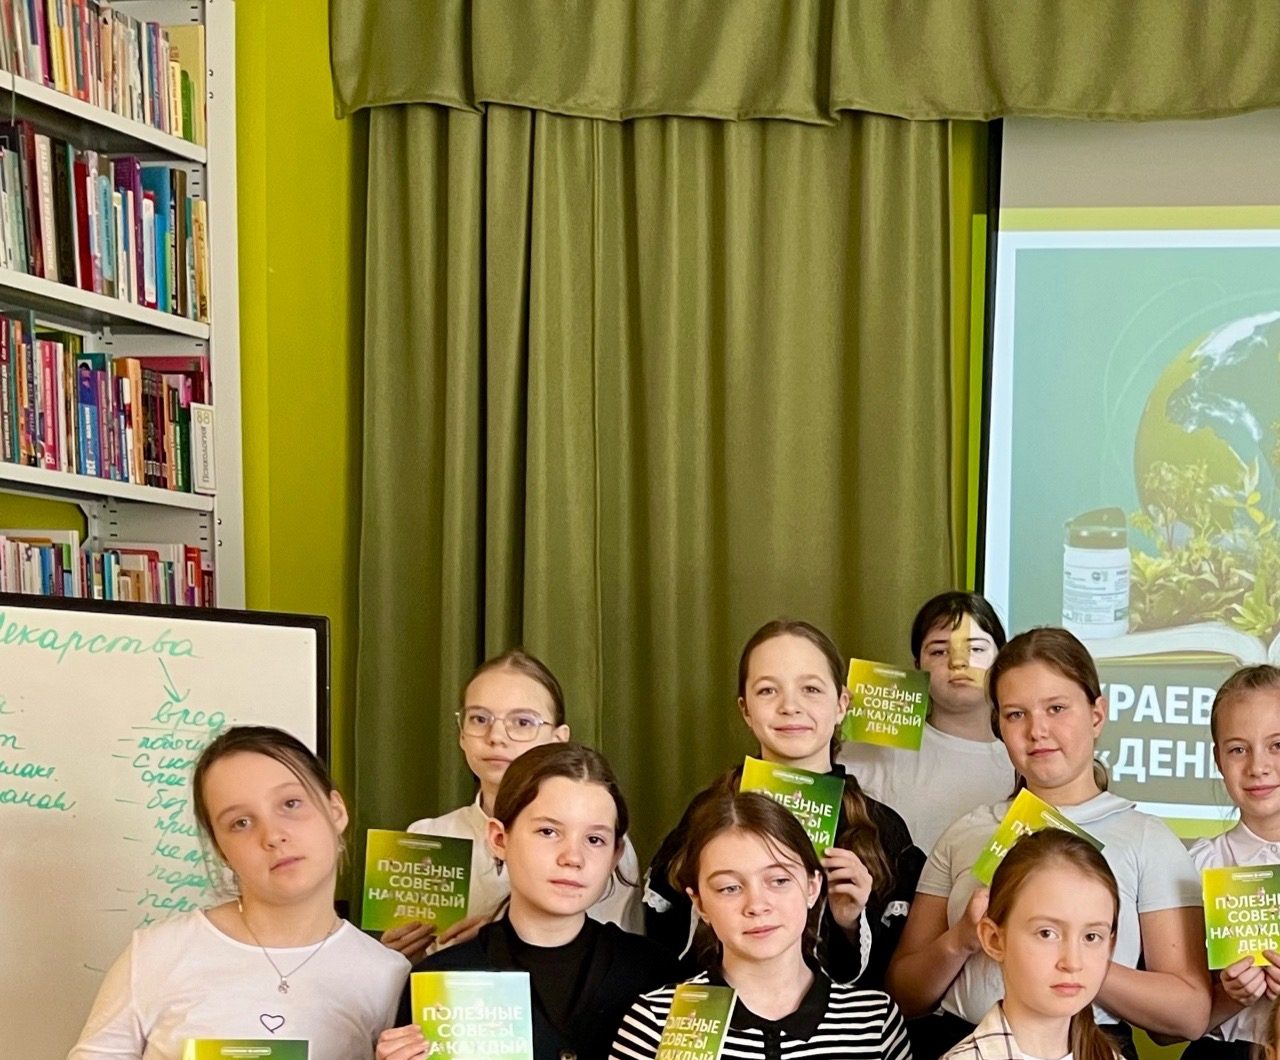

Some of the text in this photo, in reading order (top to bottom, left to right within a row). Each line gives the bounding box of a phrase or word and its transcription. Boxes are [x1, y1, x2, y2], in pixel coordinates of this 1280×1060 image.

[856, 683, 922, 704] ПОЛЕЗНЫЕ
[863, 696, 914, 714] СОВЕТЫ
[1100, 683, 1216, 725] РАЕВ
[867, 709, 922, 727] КАЖДЫЙ
[866, 722, 898, 735] ДЕНЬ
[762, 788, 833, 817] ЛЕЗНЫЕ
[378, 860, 464, 880] ПОЛЕЗНЫЕ
[389, 875, 454, 892] СОВЕТЫ
[368, 887, 465, 908] НА КАЖДЫЙ
[394, 904, 436, 920] ДЕНЬ
[1210, 926, 1233, 940] НА
[1238, 938, 1278, 954] ДЕНЬ
[422, 1006, 524, 1021] ПОЛЕЗНЫЕ
[437, 1024, 514, 1038] СОВЕТЫ
[666, 1016, 720, 1034] ОЛЕЗНЫЕ
[428, 1041, 444, 1055] А
